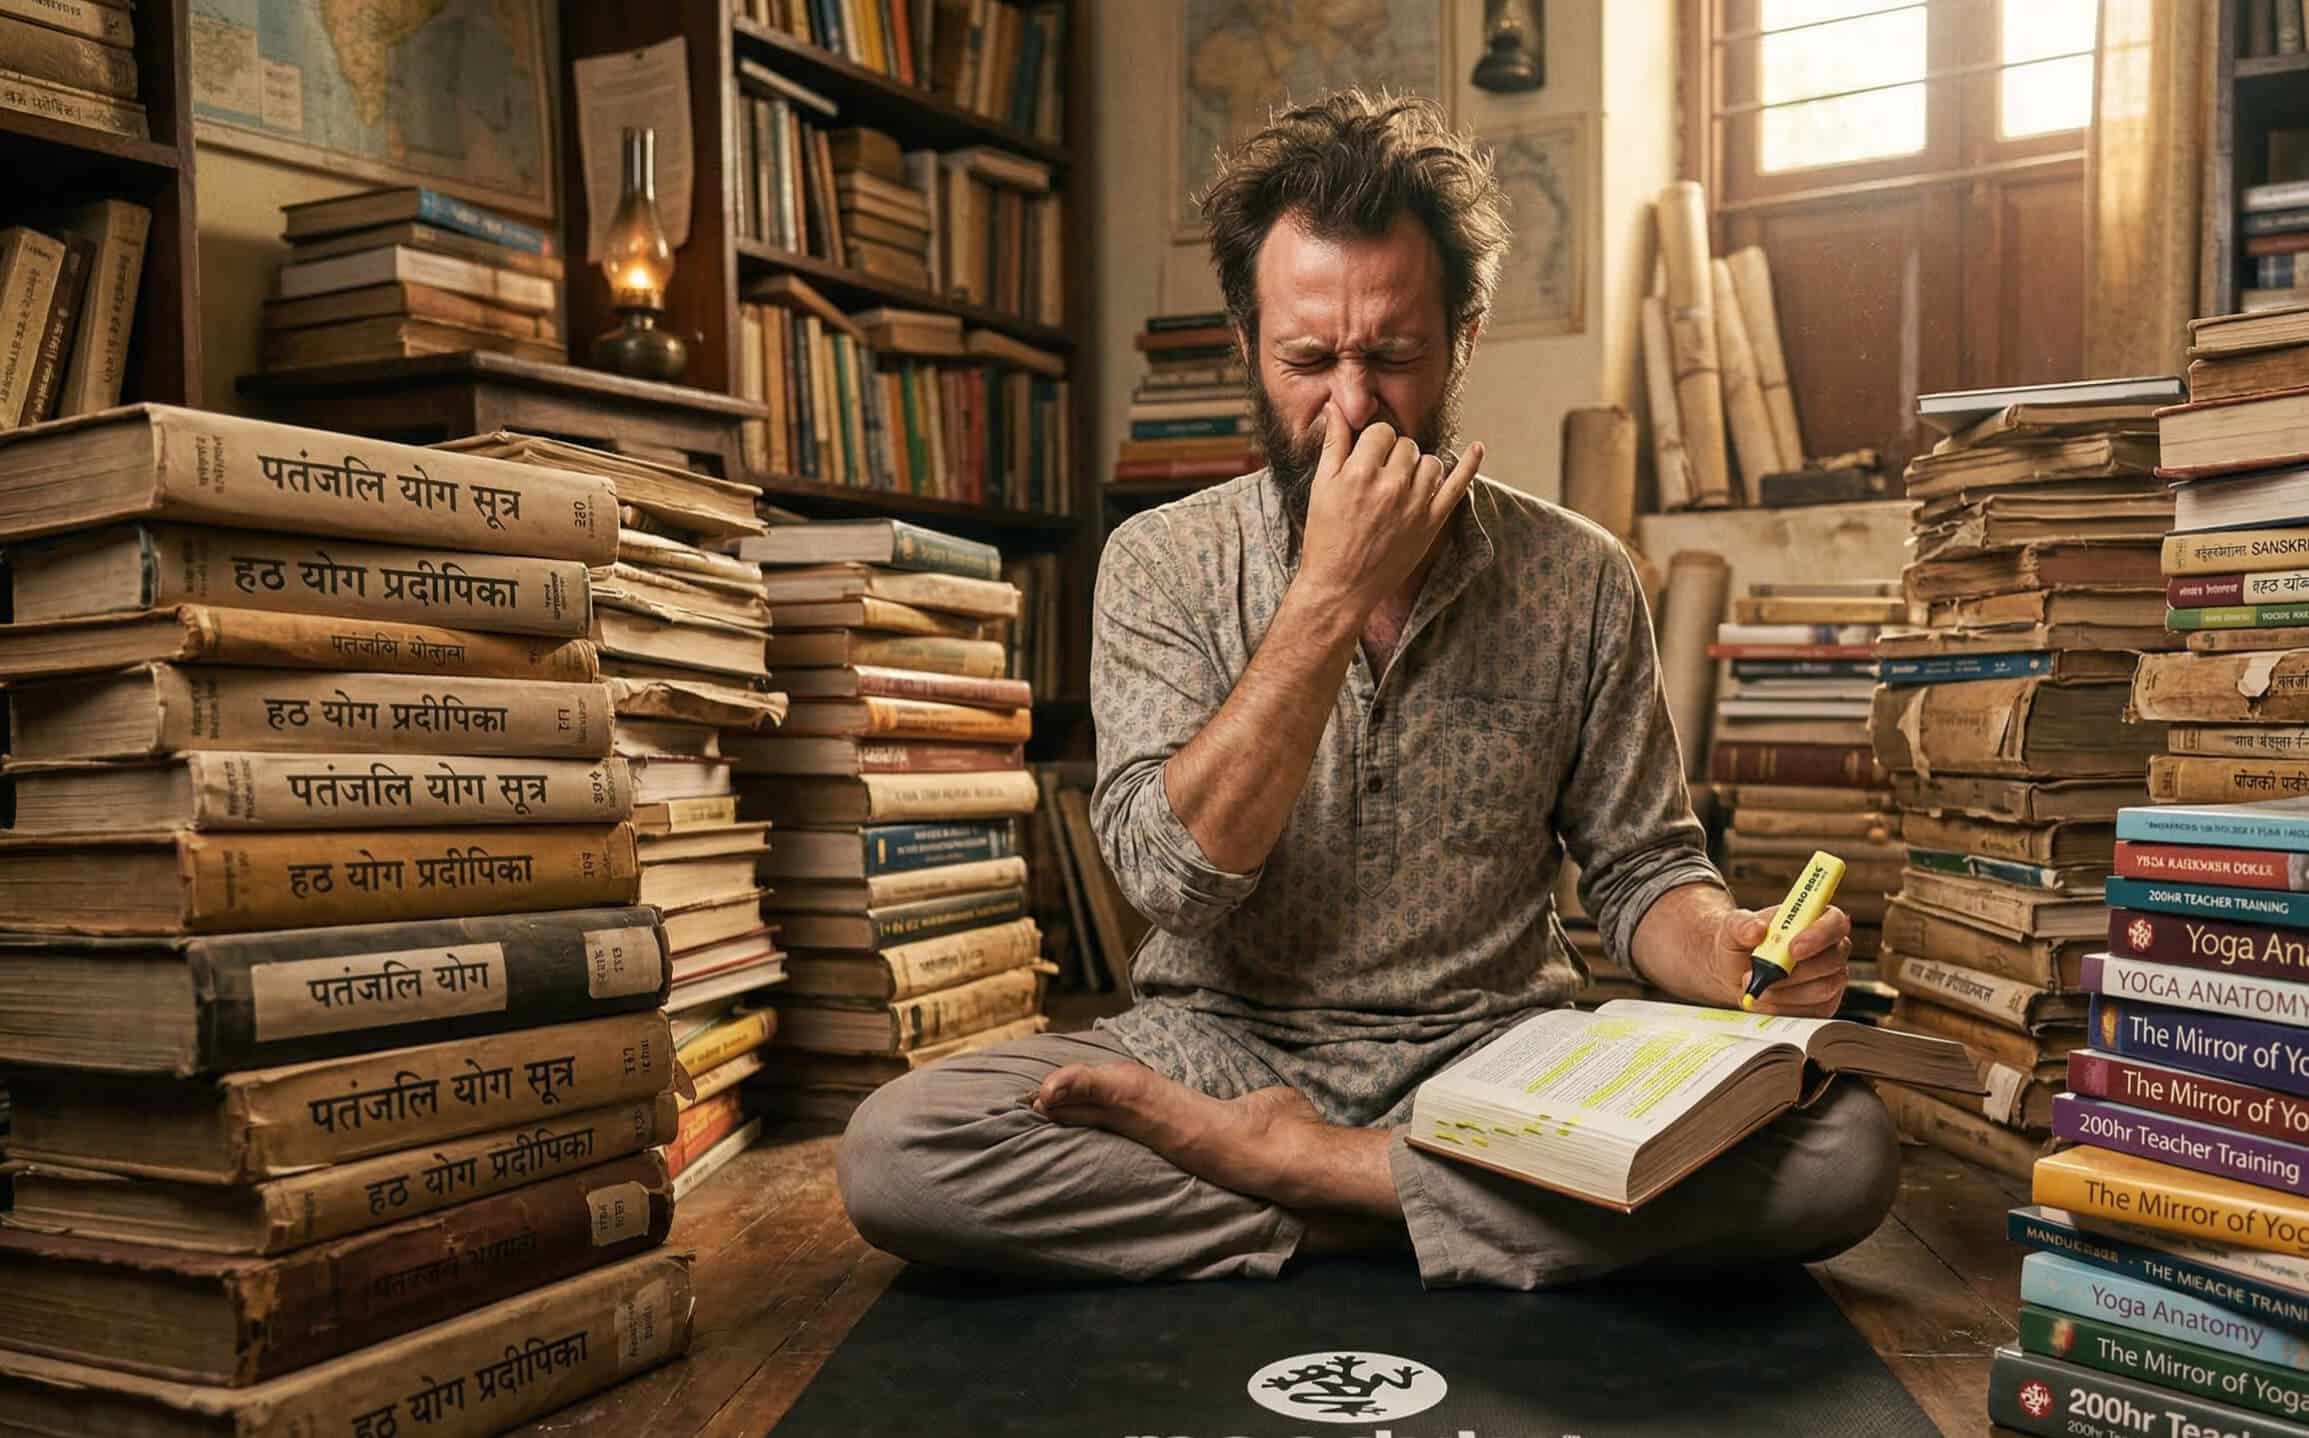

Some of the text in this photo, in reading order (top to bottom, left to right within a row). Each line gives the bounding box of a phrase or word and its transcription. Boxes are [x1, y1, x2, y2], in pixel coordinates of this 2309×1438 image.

[257, 449, 386, 503] पतंजलि
[397, 464, 458, 512] योग
[469, 485, 521, 530] सूत्र
[231, 556, 287, 594] हठ
[297, 551, 368, 597] योग
[380, 560, 519, 608] प्रदीपिका
[263, 698, 311, 731] हठ
[320, 689, 378, 729] योग
[390, 694, 509, 733] प्रदीपिका
[286, 762, 413, 806] पतंजलि
[424, 761, 486, 805] योग
[496, 774, 548, 815] सूत्र
[287, 863, 334, 898] हठ
[343, 849, 405, 889] योग
[415, 846, 534, 888] प्रदीपिका
[2148, 889, 2289, 914] 200HR TEACHER TRAINING
[2186, 923, 2255, 965] Yoga
[307, 953, 489, 1007] पतंजलि योग
[2118, 969, 2309, 1018] YOGA ANATOMY
[2129, 1016, 2169, 1048] The
[2175, 1025, 2248, 1064] Mirror
[2253, 1041, 2281, 1070] of
[308, 1071, 440, 1133] पतंजलि
[450, 1058, 513, 1105] योग
[524, 1056, 576, 1105] सूत्र
[2123, 1070, 2164, 1100] The
[2170, 1079, 2242, 1117] Mirror
[2248, 1098, 2275, 1124] of
[365, 1127, 595, 1217] हठ योग प्रदीपिका
[2079, 1113, 2300, 1184] 200hr Teacher Training
[2085, 1179, 2130, 1210] The
[2138, 1191, 2220, 1227] Mirror
[2227, 1209, 2257, 1233] of
[2143, 1259, 2172, 1282] THE
[2091, 1283, 2265, 1349] Yoga Anatomy
[407, 1376, 466, 1424] योग
[475, 1330, 588, 1401] प्रदीपिका
[2097, 1337, 2138, 1366] The
[2145, 1350, 2216, 1386] Mirror
[2222, 1372, 2248, 1394] of
[2068, 1388, 2156, 1433] 200hr
